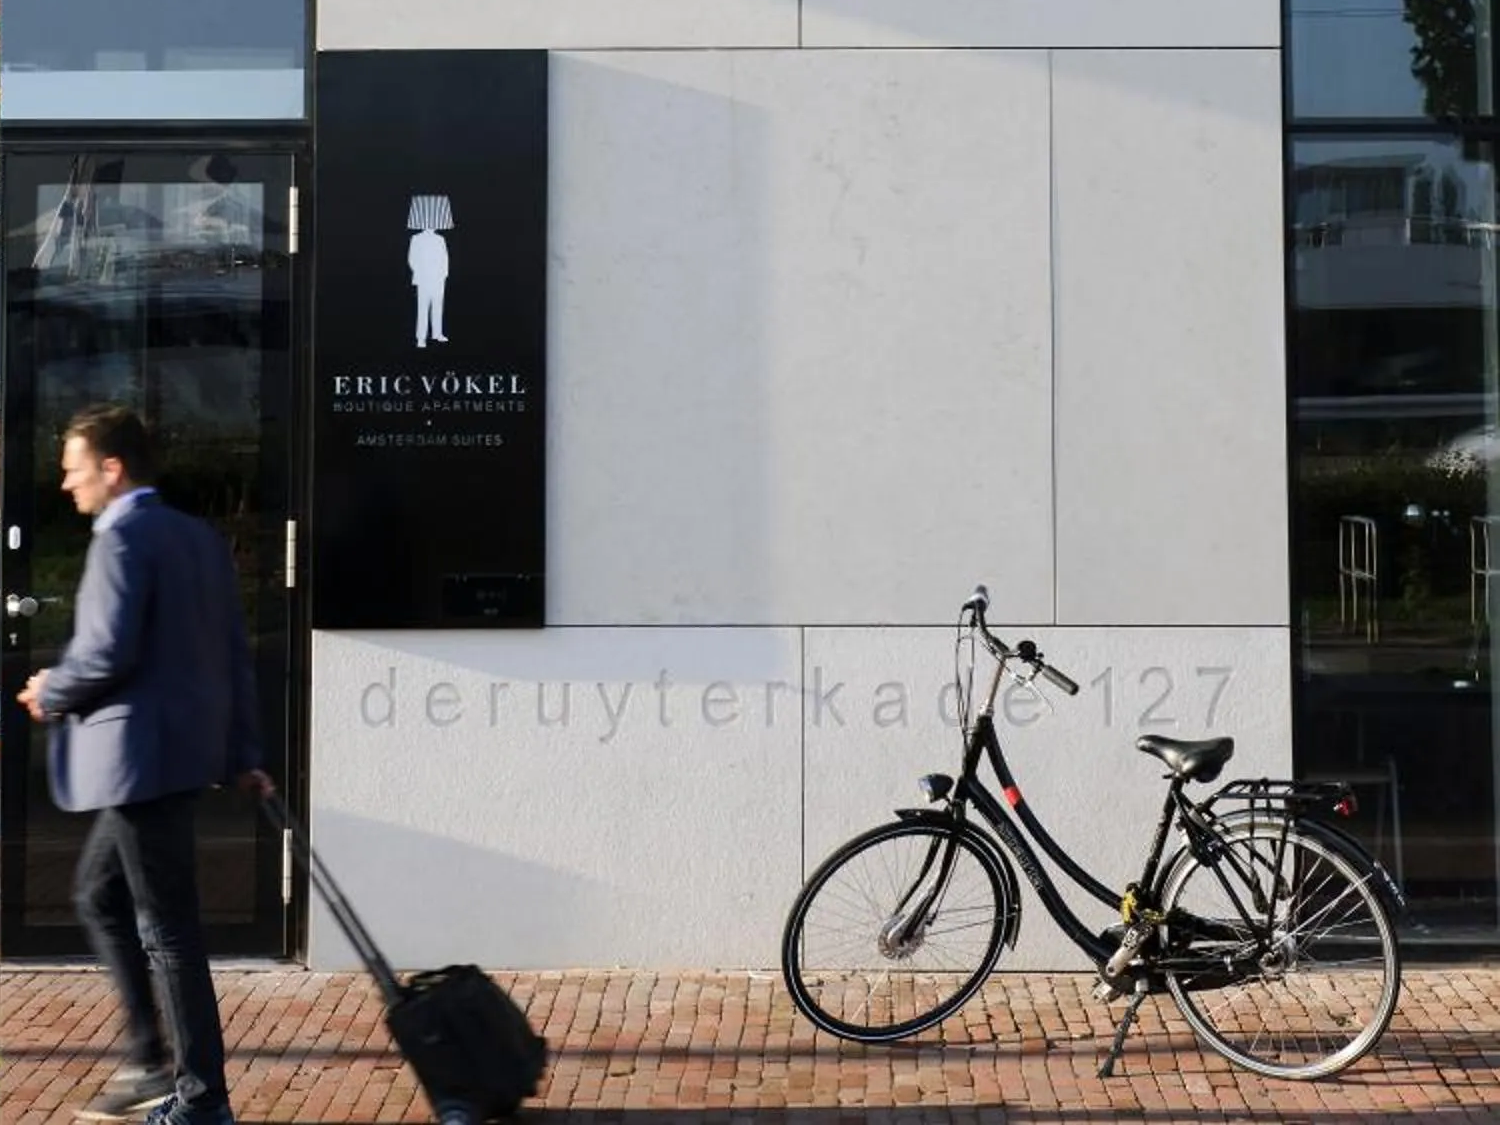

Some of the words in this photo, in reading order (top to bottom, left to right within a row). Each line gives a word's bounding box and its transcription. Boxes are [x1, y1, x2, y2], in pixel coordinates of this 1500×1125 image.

[333, 376, 411, 395] ERIC
[421, 371, 526, 395] VÖKEL
[333, 400, 414, 413] BOUTIQUE
[422, 400, 526, 413] APARTMENTS
[357, 434, 447, 446] AMSTERDAM
[452, 434, 503, 446] SUITES
[1091, 665, 1232, 728] 127
